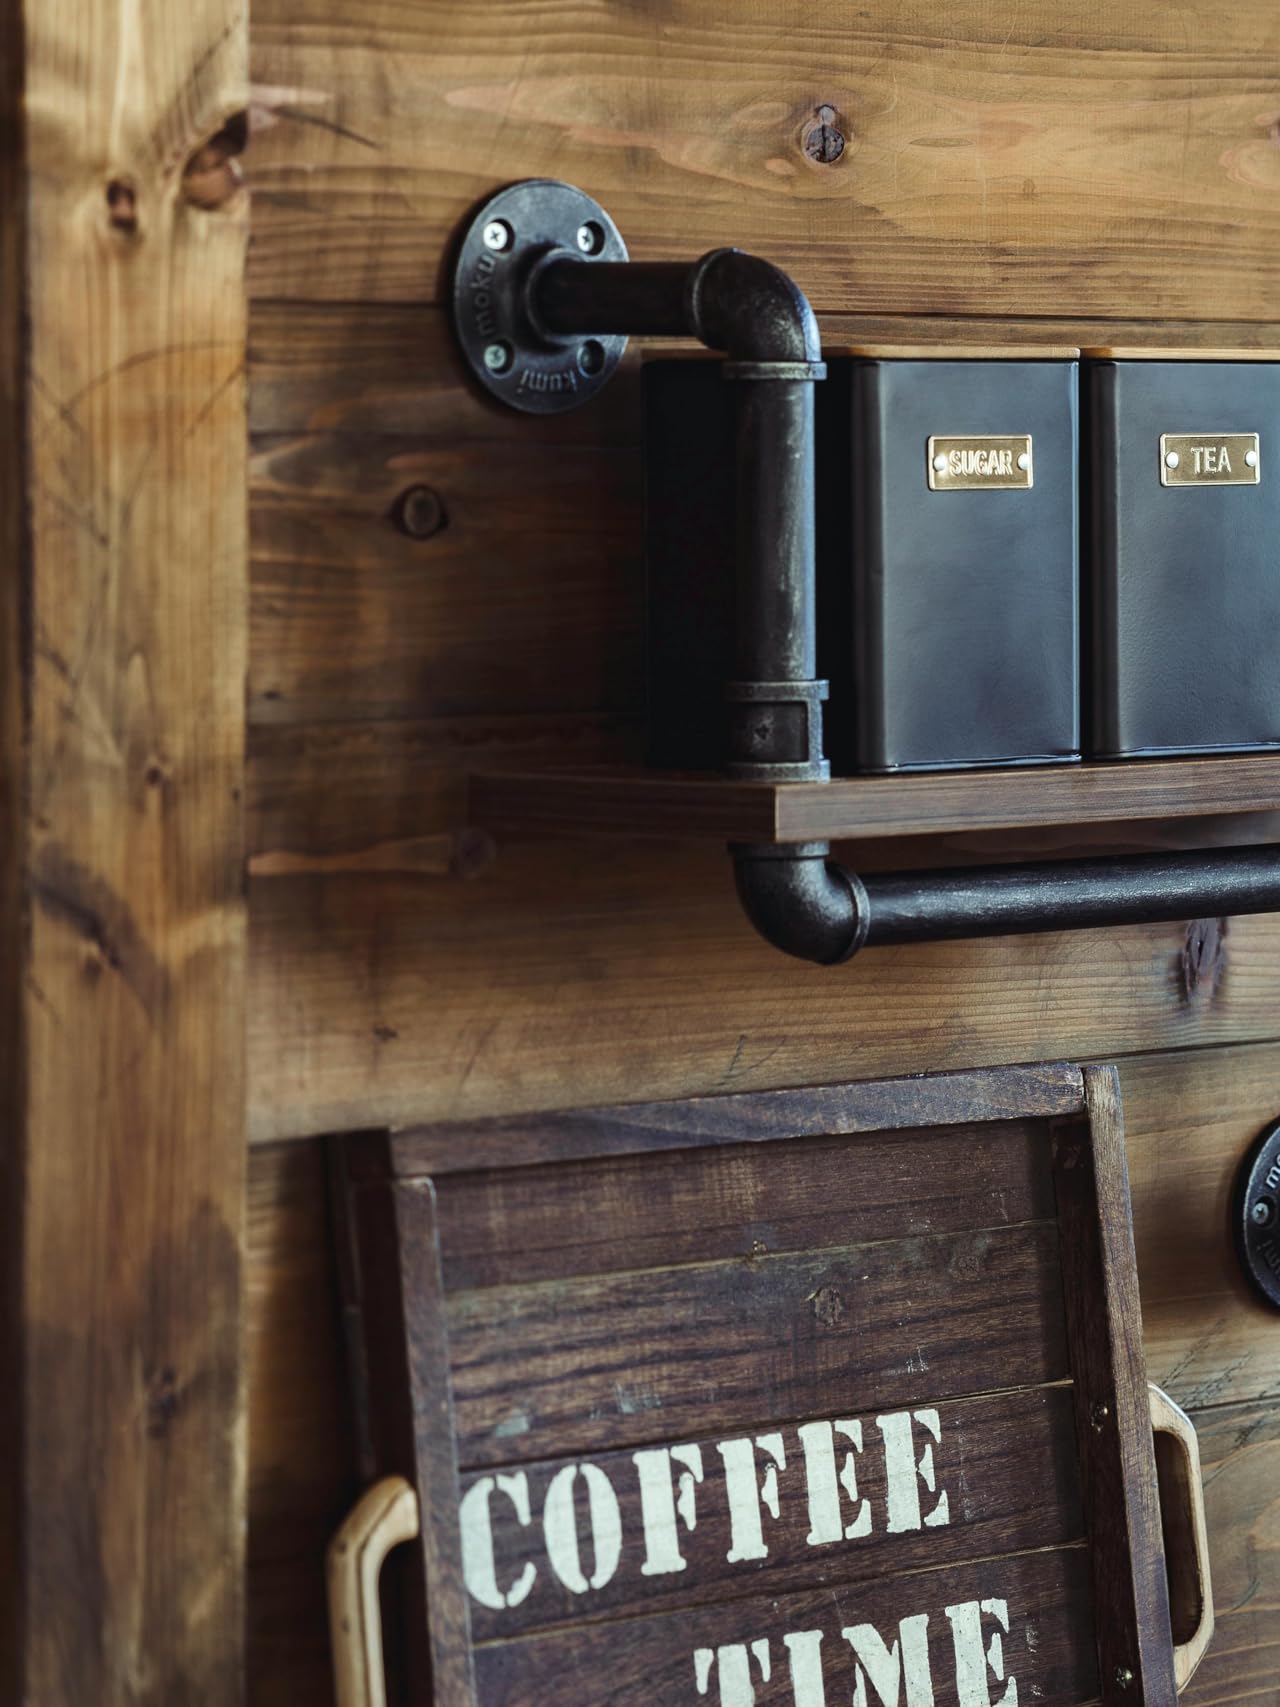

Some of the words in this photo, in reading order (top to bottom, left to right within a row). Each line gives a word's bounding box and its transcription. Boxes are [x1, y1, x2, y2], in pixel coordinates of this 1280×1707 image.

[949, 449, 1013, 477] SUGAR
[1191, 446, 1232, 474] TEA
[458, 1408, 950, 1610] COFFEE
[694, 1597, 1018, 1707] TIME
